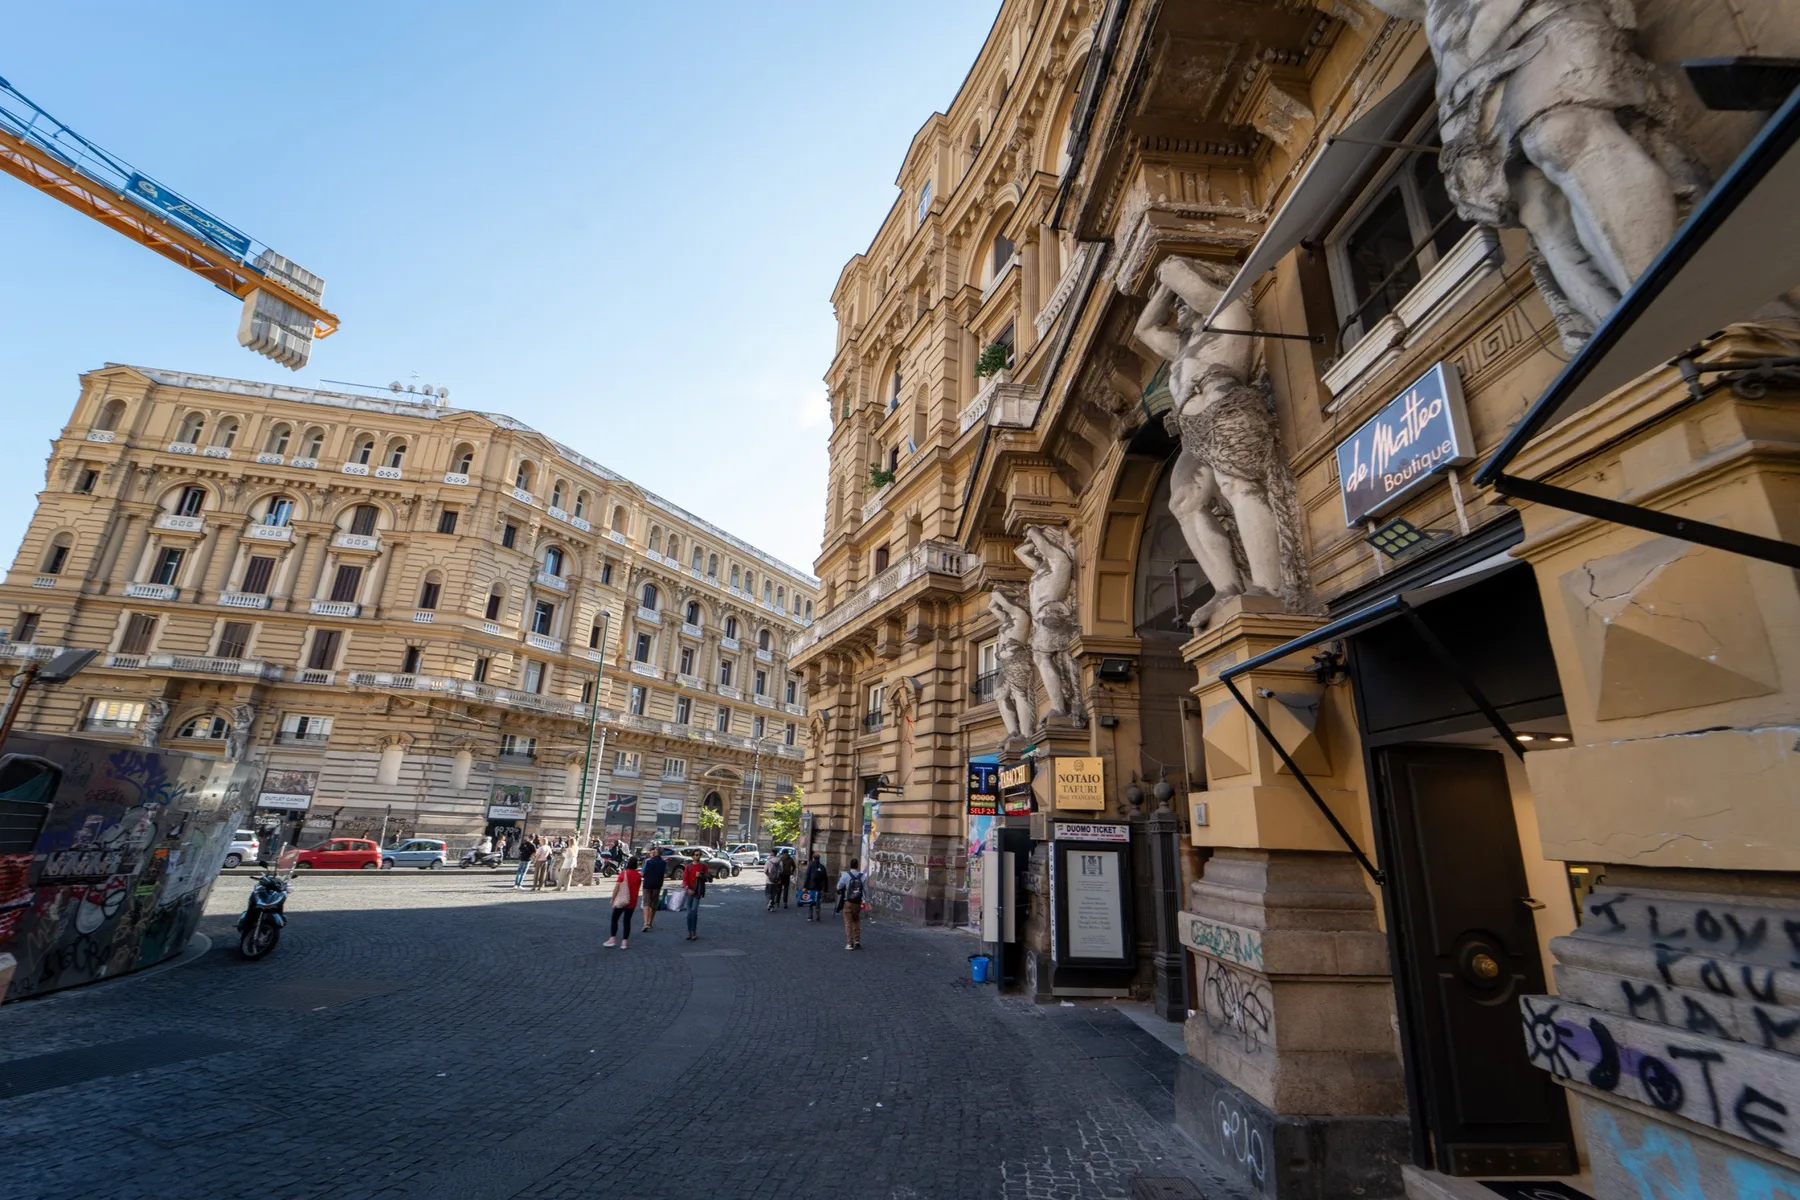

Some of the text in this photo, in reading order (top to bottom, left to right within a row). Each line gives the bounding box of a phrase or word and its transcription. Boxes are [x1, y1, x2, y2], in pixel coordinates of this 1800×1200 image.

[1346, 389, 1443, 492] de Matteo
[1383, 439, 1452, 493] Boutique
[1058, 773, 1100, 783] NOTAIO
[1061, 785, 1097, 793] TAFURI
[1066, 825, 1091, 833] DUOMO
[1092, 826, 1117, 834] TICKET
